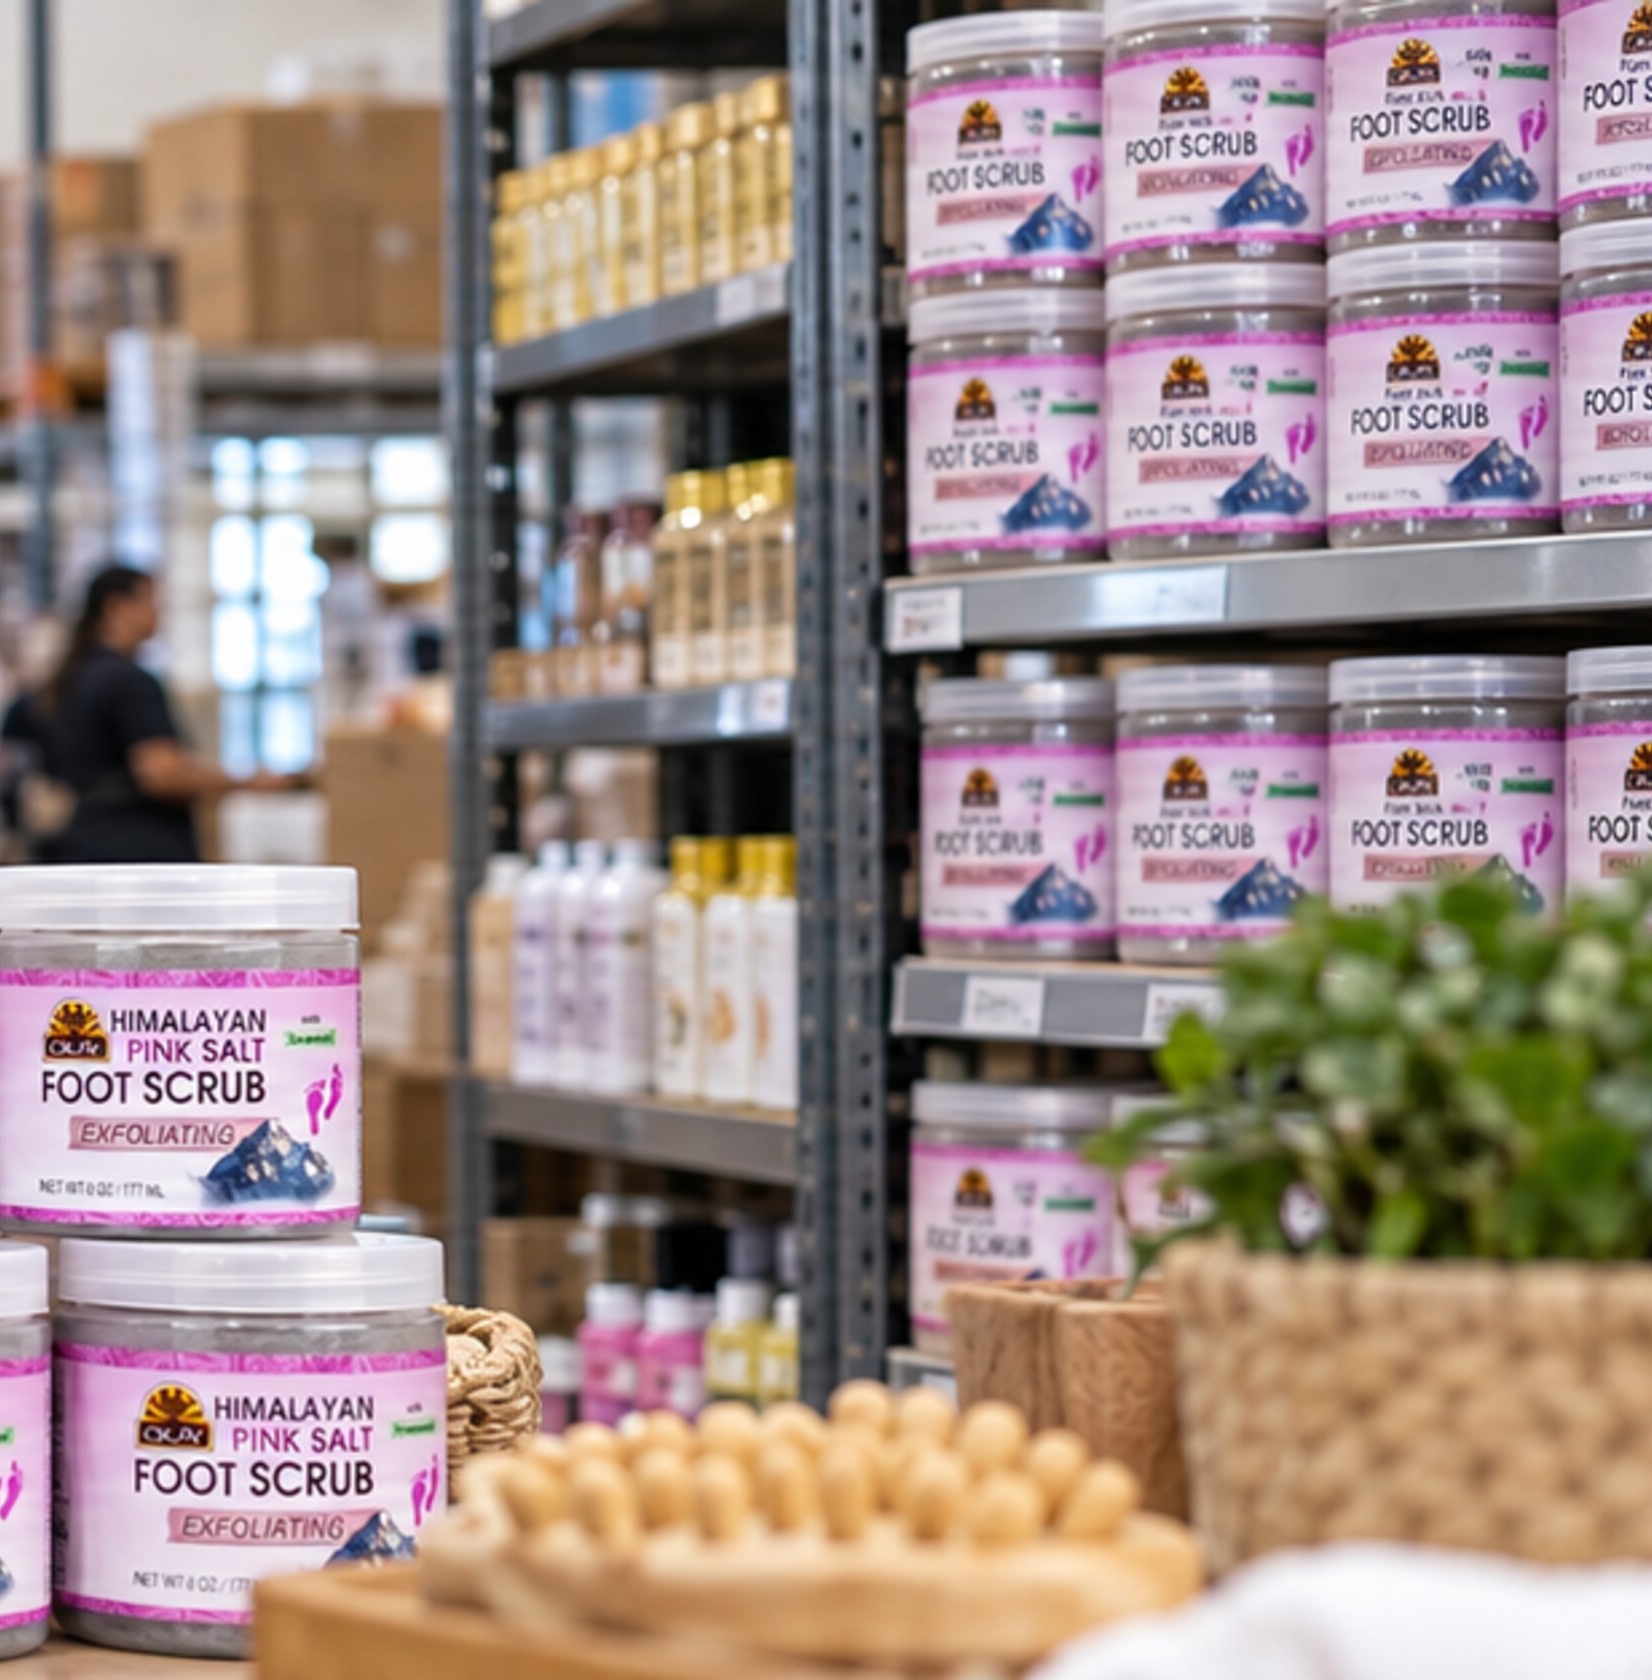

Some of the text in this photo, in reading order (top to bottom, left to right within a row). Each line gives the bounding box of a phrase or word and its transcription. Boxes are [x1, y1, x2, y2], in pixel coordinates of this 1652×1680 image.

[1584, 78, 1637, 112] FOOT
[1350, 105, 1491, 142] FOOT SCRUB
[1125, 131, 1257, 165] FOOT SCRUB
[927, 161, 1045, 195] FOOT SCRUB
[1584, 385, 1637, 417] FOOT
[1352, 403, 1489, 436] FOOT SCRUB
[1128, 420, 1256, 452] FOOT SCRUB
[926, 440, 1038, 469] FOOT SCRUB
[1133, 823, 1255, 850] FOOT SCRUB
[1352, 820, 1488, 847] FOOT SCRUB
[1589, 815, 1640, 843] FOOT
[110, 1010, 265, 1032] HIMALAYAN
[128, 1039, 264, 1062] PINK SALT
[43, 1071, 265, 1103] FOOT SCRUB
[80, 1124, 235, 1145] EXFOLIATING
[215, 1396, 373, 1420] HIMALAYAN
[233, 1428, 372, 1452] PINK SALT
[134, 1459, 373, 1496] FOOT SCRUB
[182, 1516, 343, 1540] EXFOLIATING
[133, 1571, 157, 1587] NET
[161, 1573, 183, 1589] WT
[197, 1575, 216, 1592] OZ
